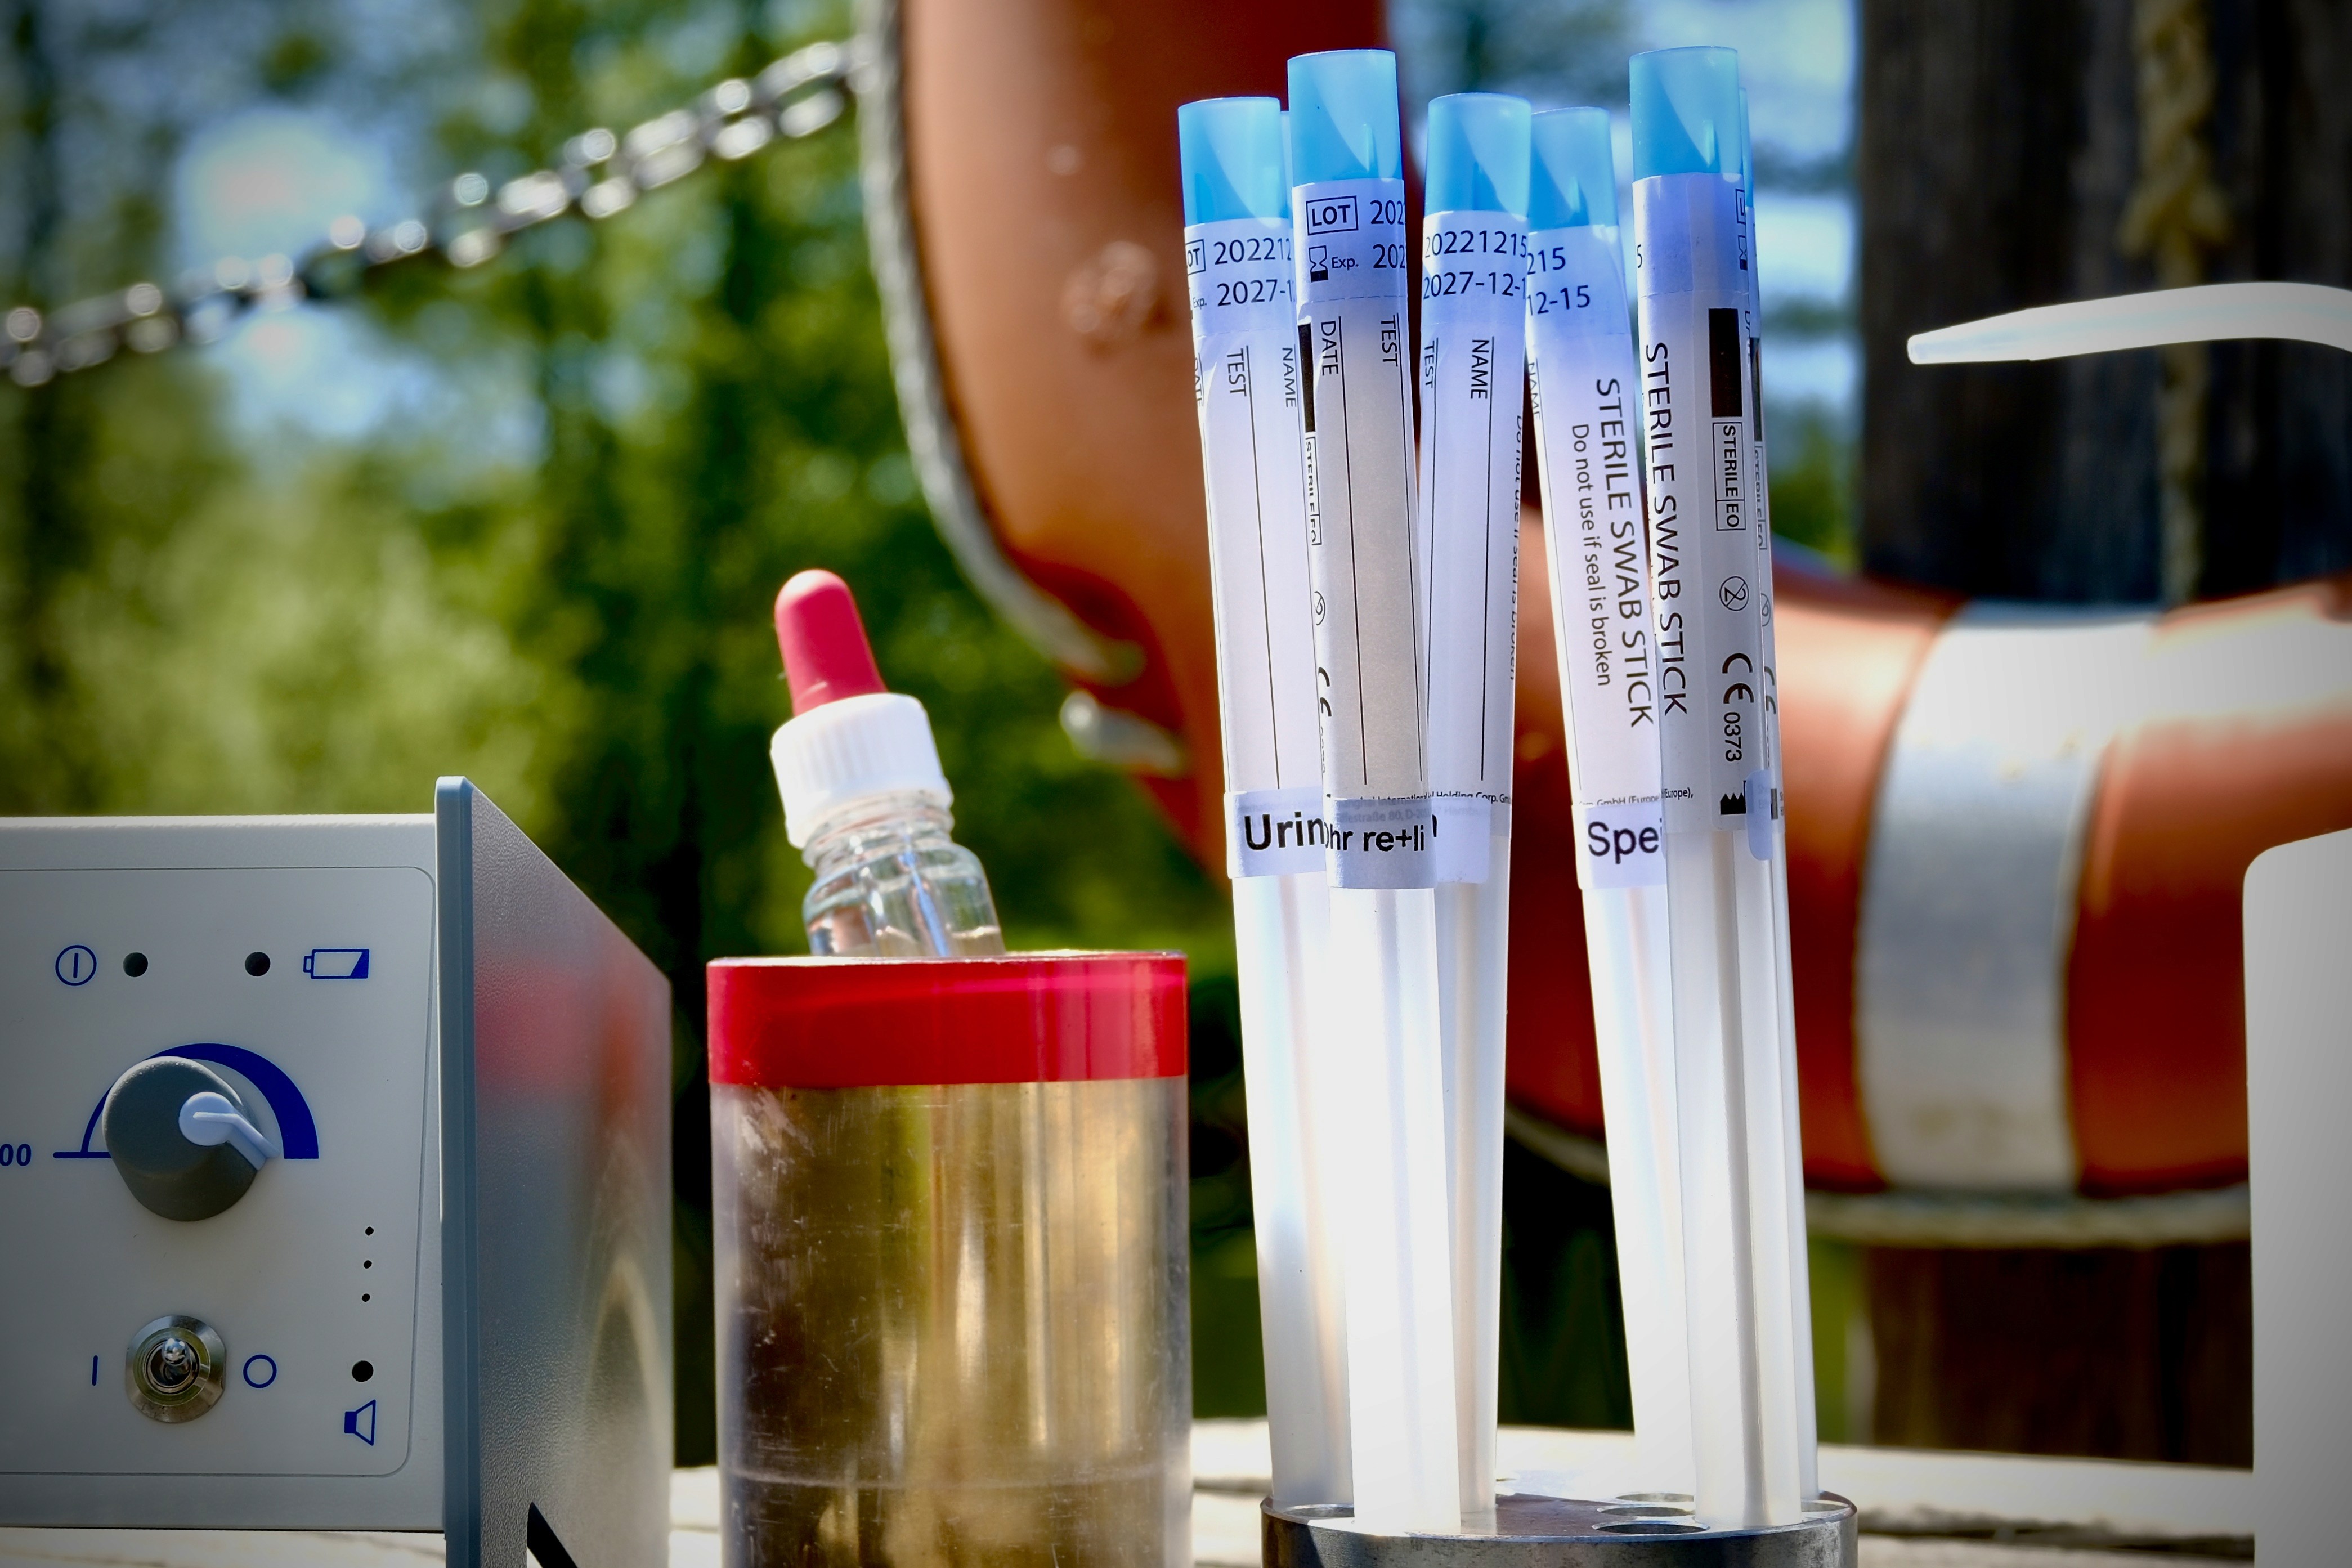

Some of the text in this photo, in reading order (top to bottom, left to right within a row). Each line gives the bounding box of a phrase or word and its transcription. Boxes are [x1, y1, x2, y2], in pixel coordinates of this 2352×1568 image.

[1312, 204, 1351, 227] LOT
[1213, 237, 1292, 265] 202212
[1331, 257, 1359, 271] Exp.
[1424, 230, 1527, 258] 20221215
[1527, 247, 1566, 275] 215
[1193, 297, 1207, 310] Exp.
[1423, 271, 1526, 301] 2027-12-1
[1527, 285, 1591, 316] 12-15
[1321, 320, 1338, 376] DATE
[1381, 315, 1398, 367] TEST
[1424, 340, 1435, 388] TEST
[1226, 348, 1247, 397] TEST
[1282, 347, 1297, 408] NAME
[1470, 339, 1490, 400] NAME
[1723, 425, 1740, 528] STERILE EO
[1646, 342, 1687, 716] STERILE SWAB STICK
[1572, 424, 1612, 686] Do not use if seal is broken
[1596, 378, 1654, 728] STERILE SWAB STICK
[1723, 711, 1742, 763] 0373
[1244, 811, 1325, 851] Urin
[1324, 821, 1354, 851] hr
[1363, 825, 1424, 852] re+li
[1588, 818, 1662, 865] Spe
